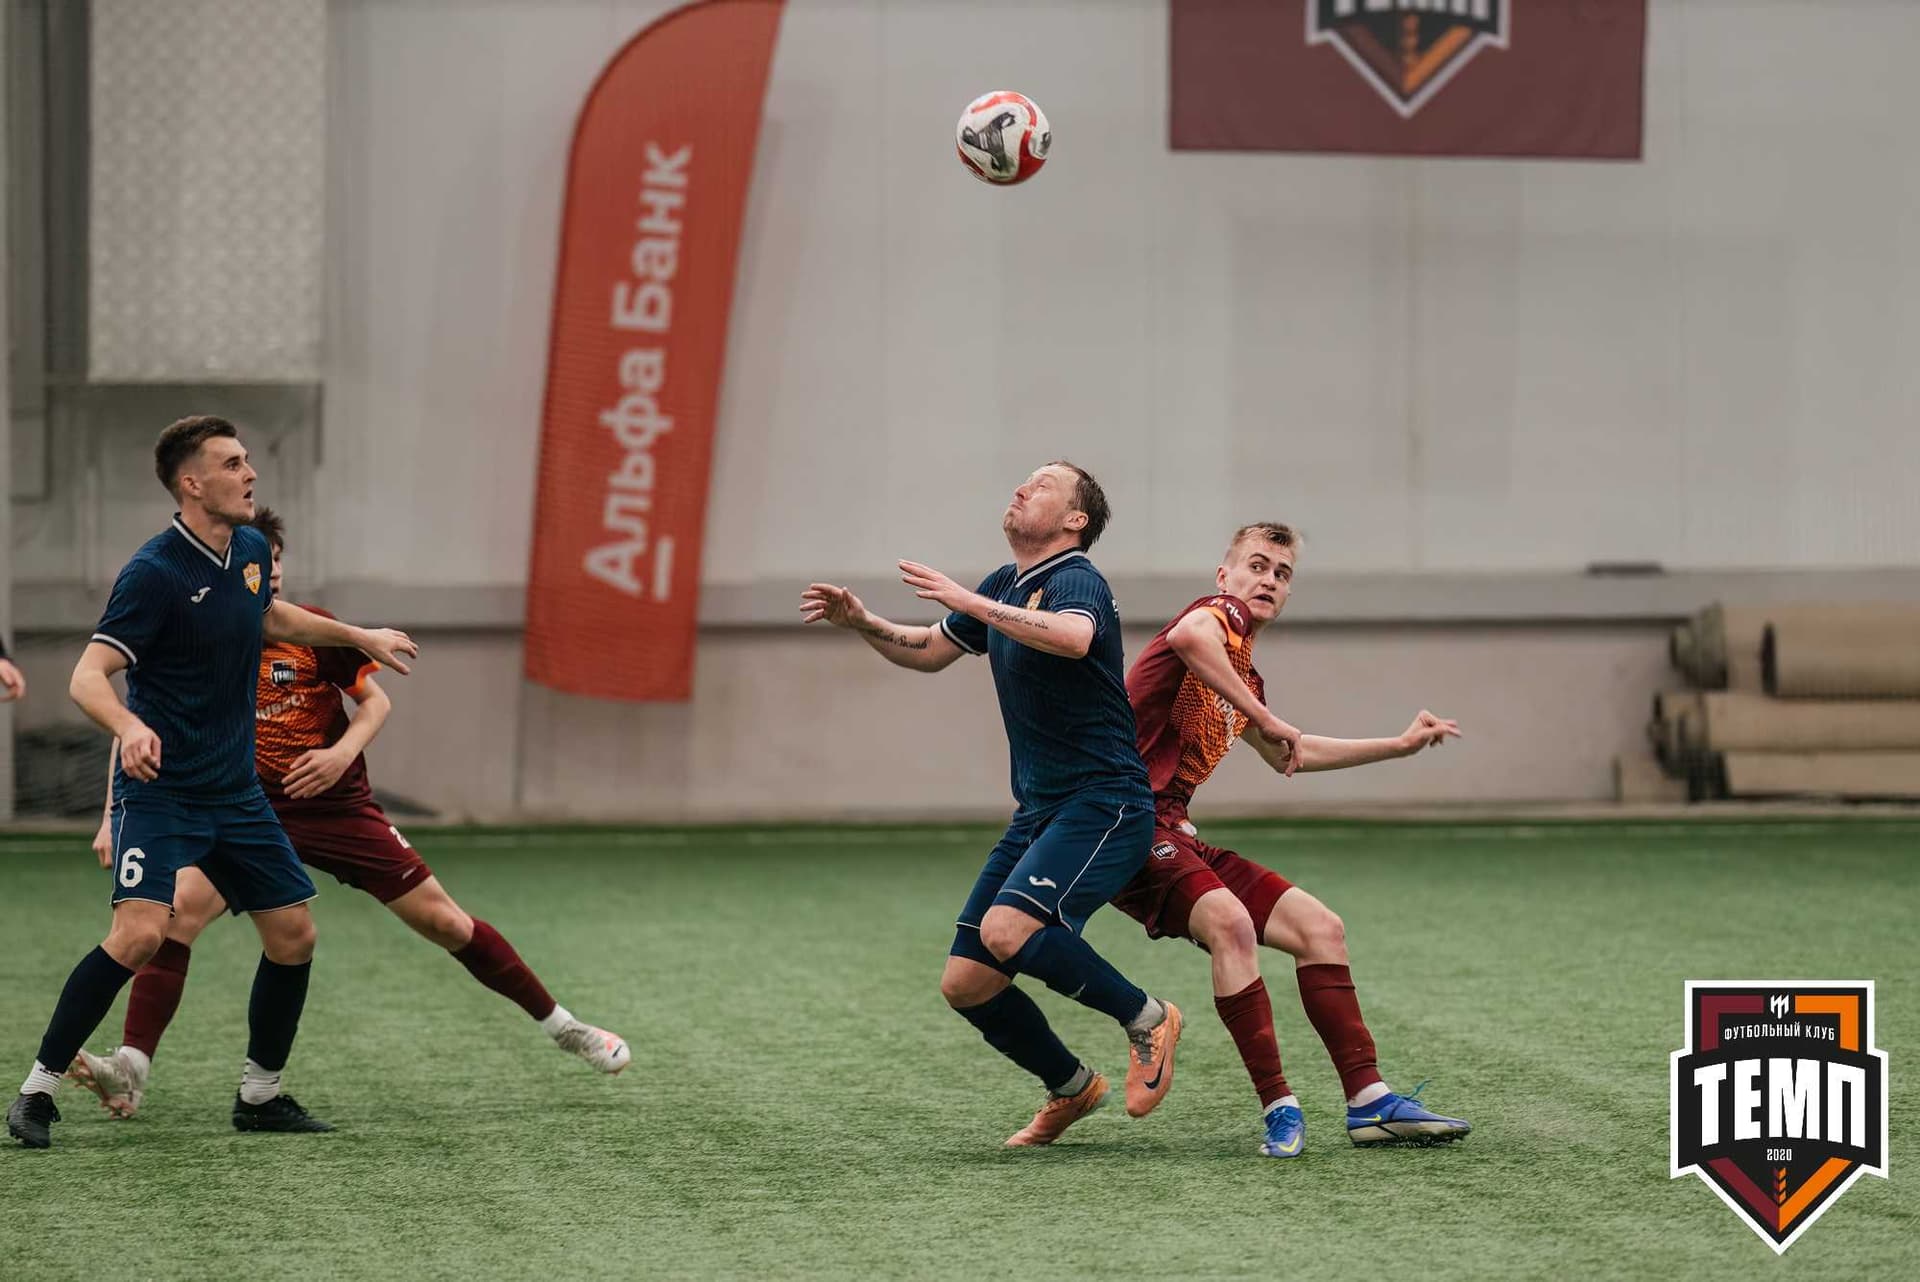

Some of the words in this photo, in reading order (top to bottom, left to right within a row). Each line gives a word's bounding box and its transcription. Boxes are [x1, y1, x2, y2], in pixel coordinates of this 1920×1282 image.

[610, 141, 693, 333] Банк
[581, 346, 674, 596] Альфа
[120, 847, 146, 888] 6
